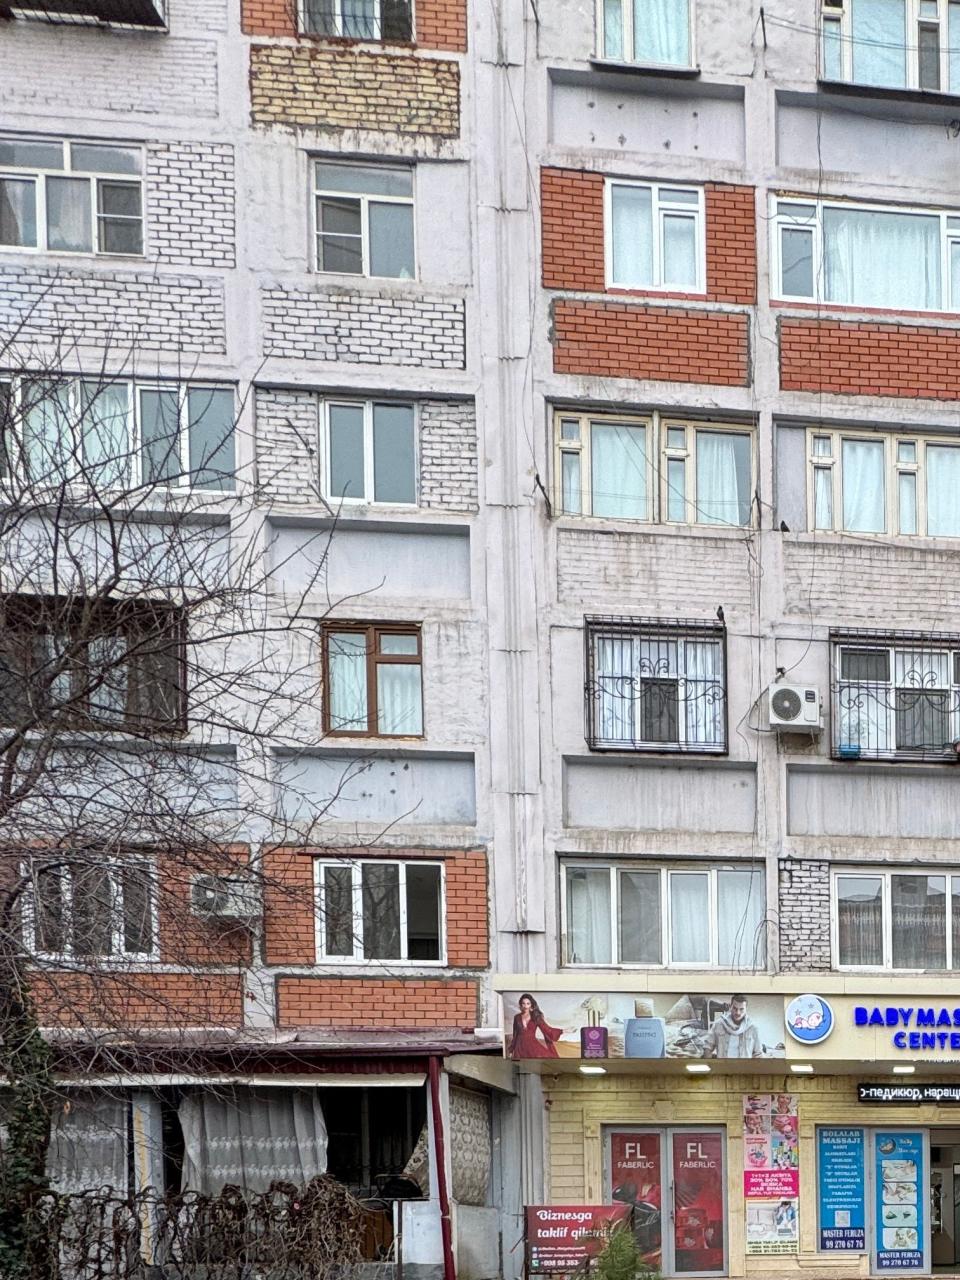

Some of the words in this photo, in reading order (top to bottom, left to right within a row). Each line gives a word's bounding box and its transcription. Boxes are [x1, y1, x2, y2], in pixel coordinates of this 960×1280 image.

[625, 1143, 647, 1159] FL
[686, 1142, 708, 1159] FL
[617, 1161, 655, 1169] FABERLIC
[679, 1161, 717, 1169] FABERLIC
[536, 1210, 593, 1223] Biznesga
[537, 1227, 569, 1238] taklif
[822, 1229, 844, 1238] MASTER
[825, 1240, 834, 1249] 99
[834, 1239, 845, 1249] 270
[846, 1240, 855, 1248] 67
[855, 1239, 864, 1248] 76
